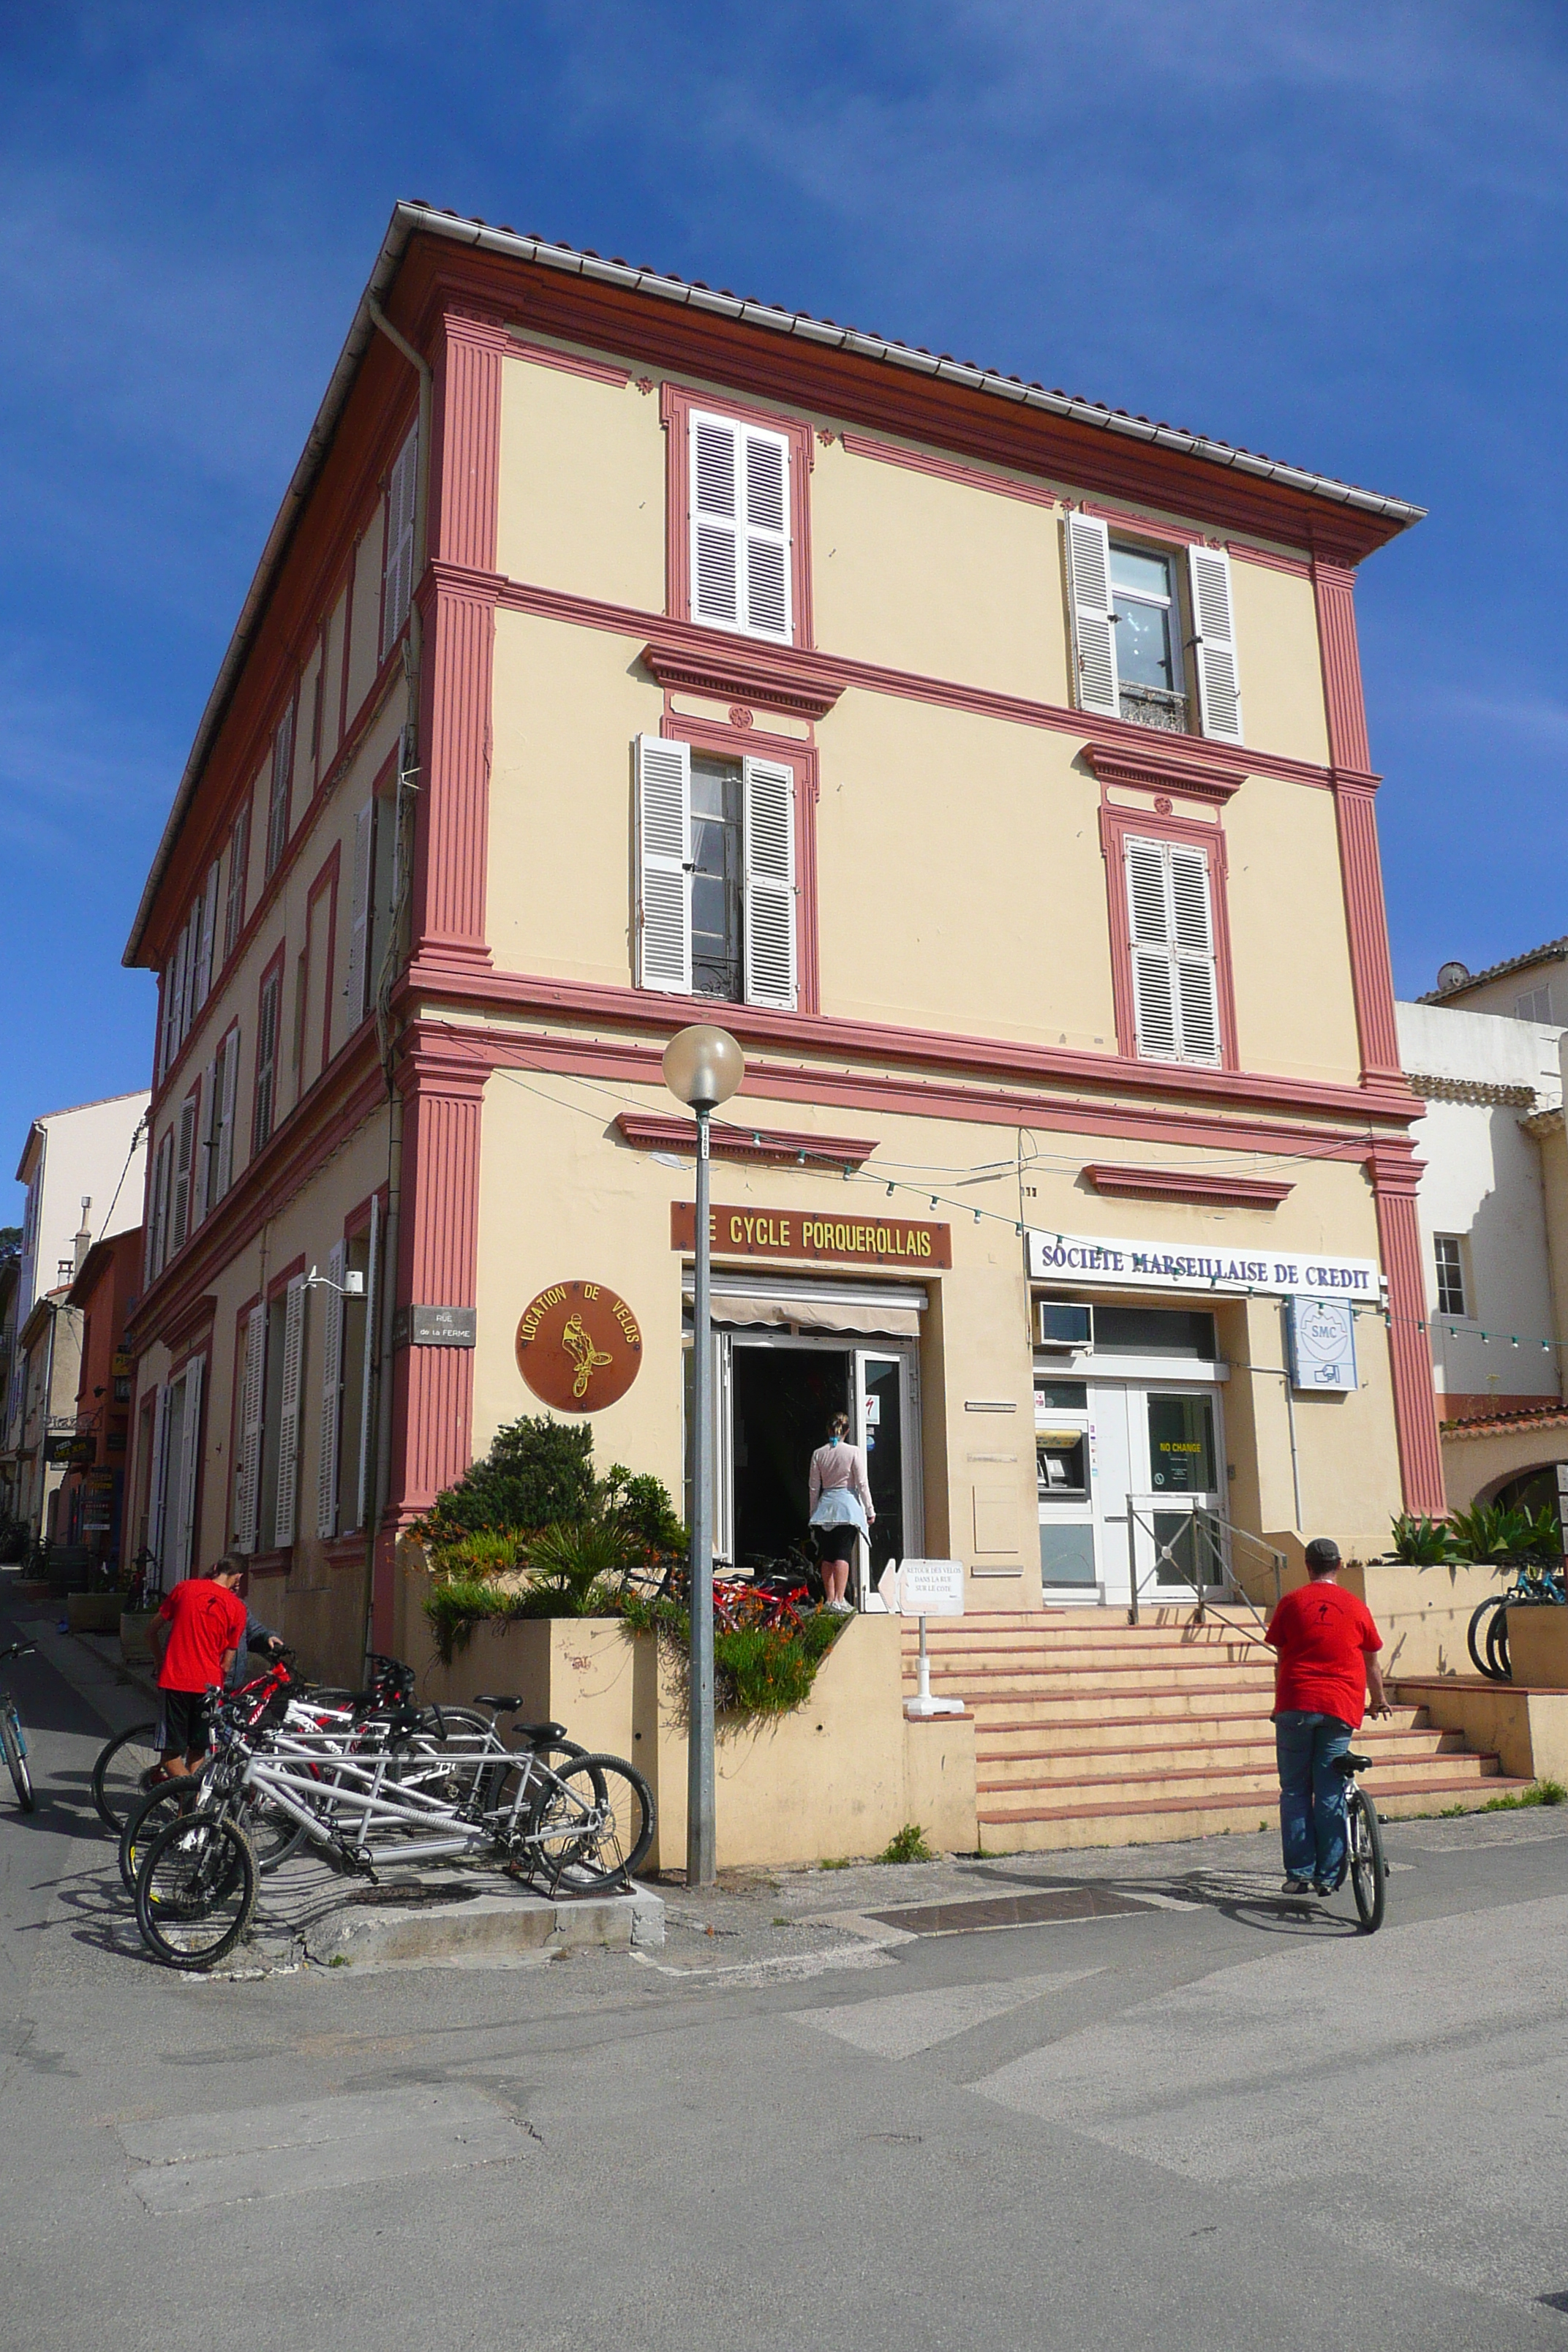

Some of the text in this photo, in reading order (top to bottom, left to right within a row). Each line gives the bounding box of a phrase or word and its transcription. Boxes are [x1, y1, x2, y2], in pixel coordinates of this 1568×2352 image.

[730, 1215, 791, 1247] CYCLE
[802, 1221, 932, 1257] PORQUEROLLAIS
[1131, 1252, 1268, 1282] MARSEILLAISE
[1274, 1264, 1299, 1284] DE
[1305, 1266, 1371, 1289] CREDIT
[436, 1314, 453, 1322] RUE
[520, 1284, 640, 1343] LOCATION DE VELOS
[442, 1330, 471, 1338] FERME
[1311, 1325, 1337, 1338] SMC
[1159, 1442, 1202, 1452] NO CHANGE
